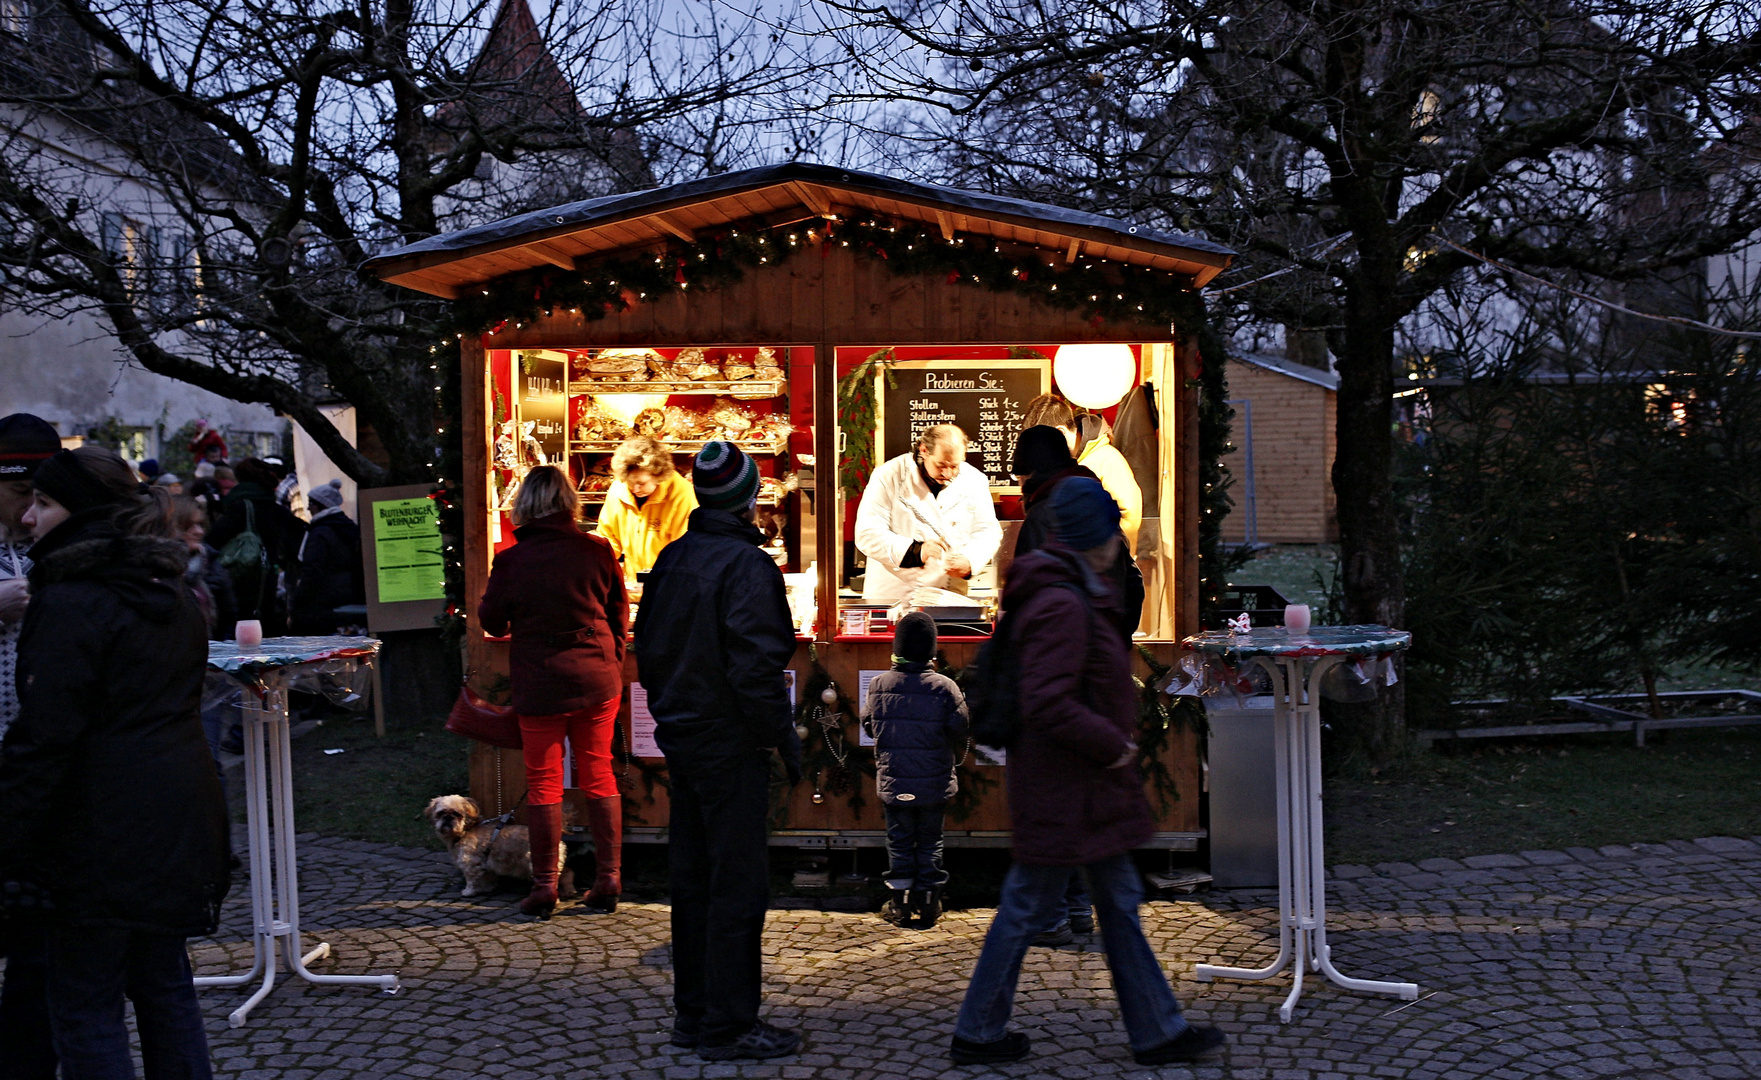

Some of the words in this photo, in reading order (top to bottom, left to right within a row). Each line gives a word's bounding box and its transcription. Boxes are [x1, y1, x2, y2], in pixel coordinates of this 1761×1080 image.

[925, 372, 975, 389] Probieren
[978, 371, 1004, 389] Sie:
[909, 398, 939, 410] Stollen
[979, 397, 999, 409] Stück
[909, 409, 956, 421] Stollenstern
[979, 411, 1000, 421] Stück
[983, 441, 1003, 452] Stück
[983, 452, 1002, 462] Stück
[983, 462, 1003, 472] Stück
